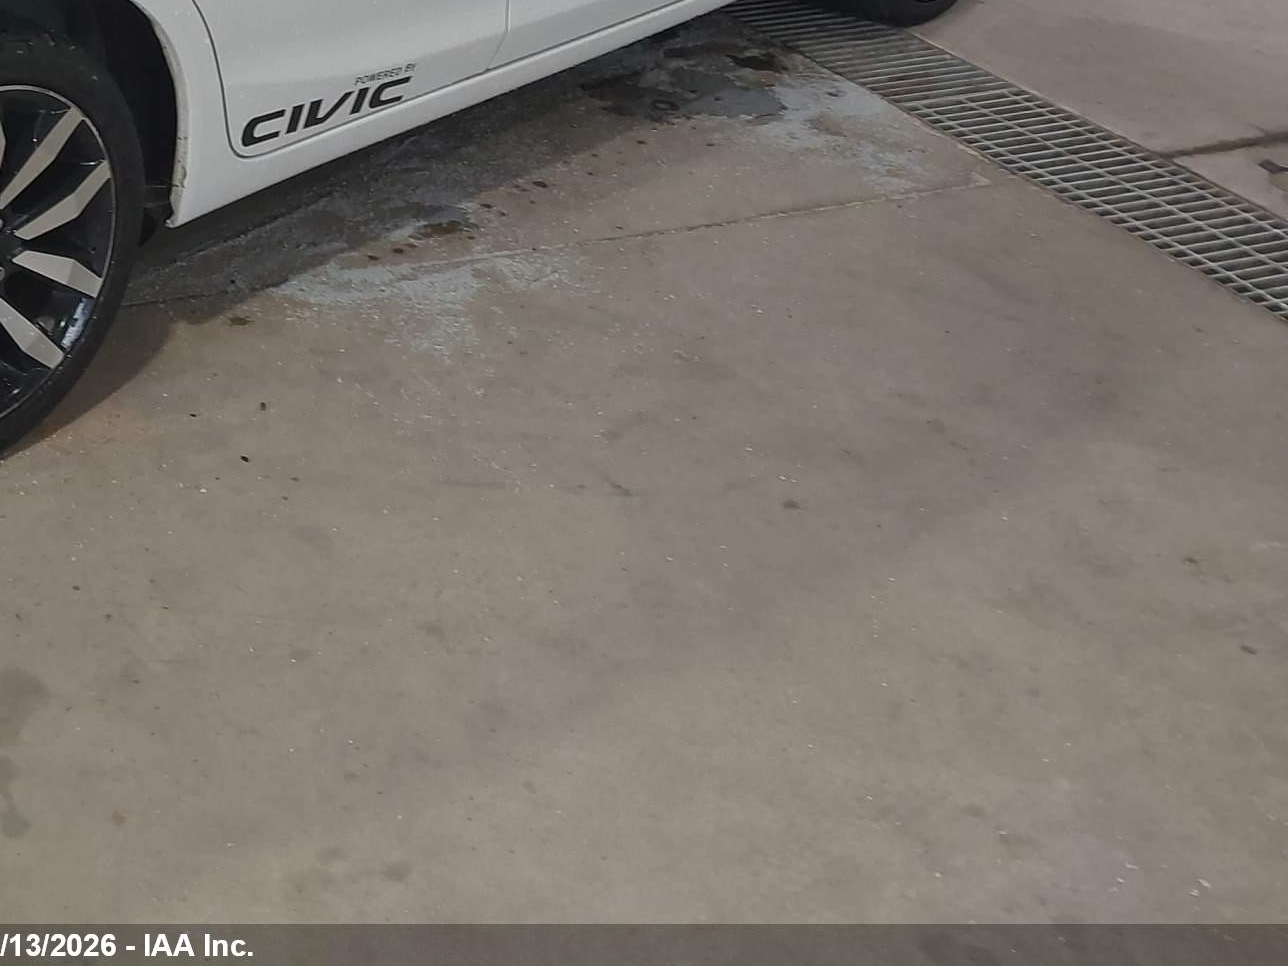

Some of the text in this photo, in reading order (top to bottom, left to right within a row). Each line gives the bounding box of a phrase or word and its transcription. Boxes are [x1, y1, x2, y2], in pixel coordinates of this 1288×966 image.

[354, 62, 418, 86] POWERED BY
[241, 76, 413, 148] CIVIC
